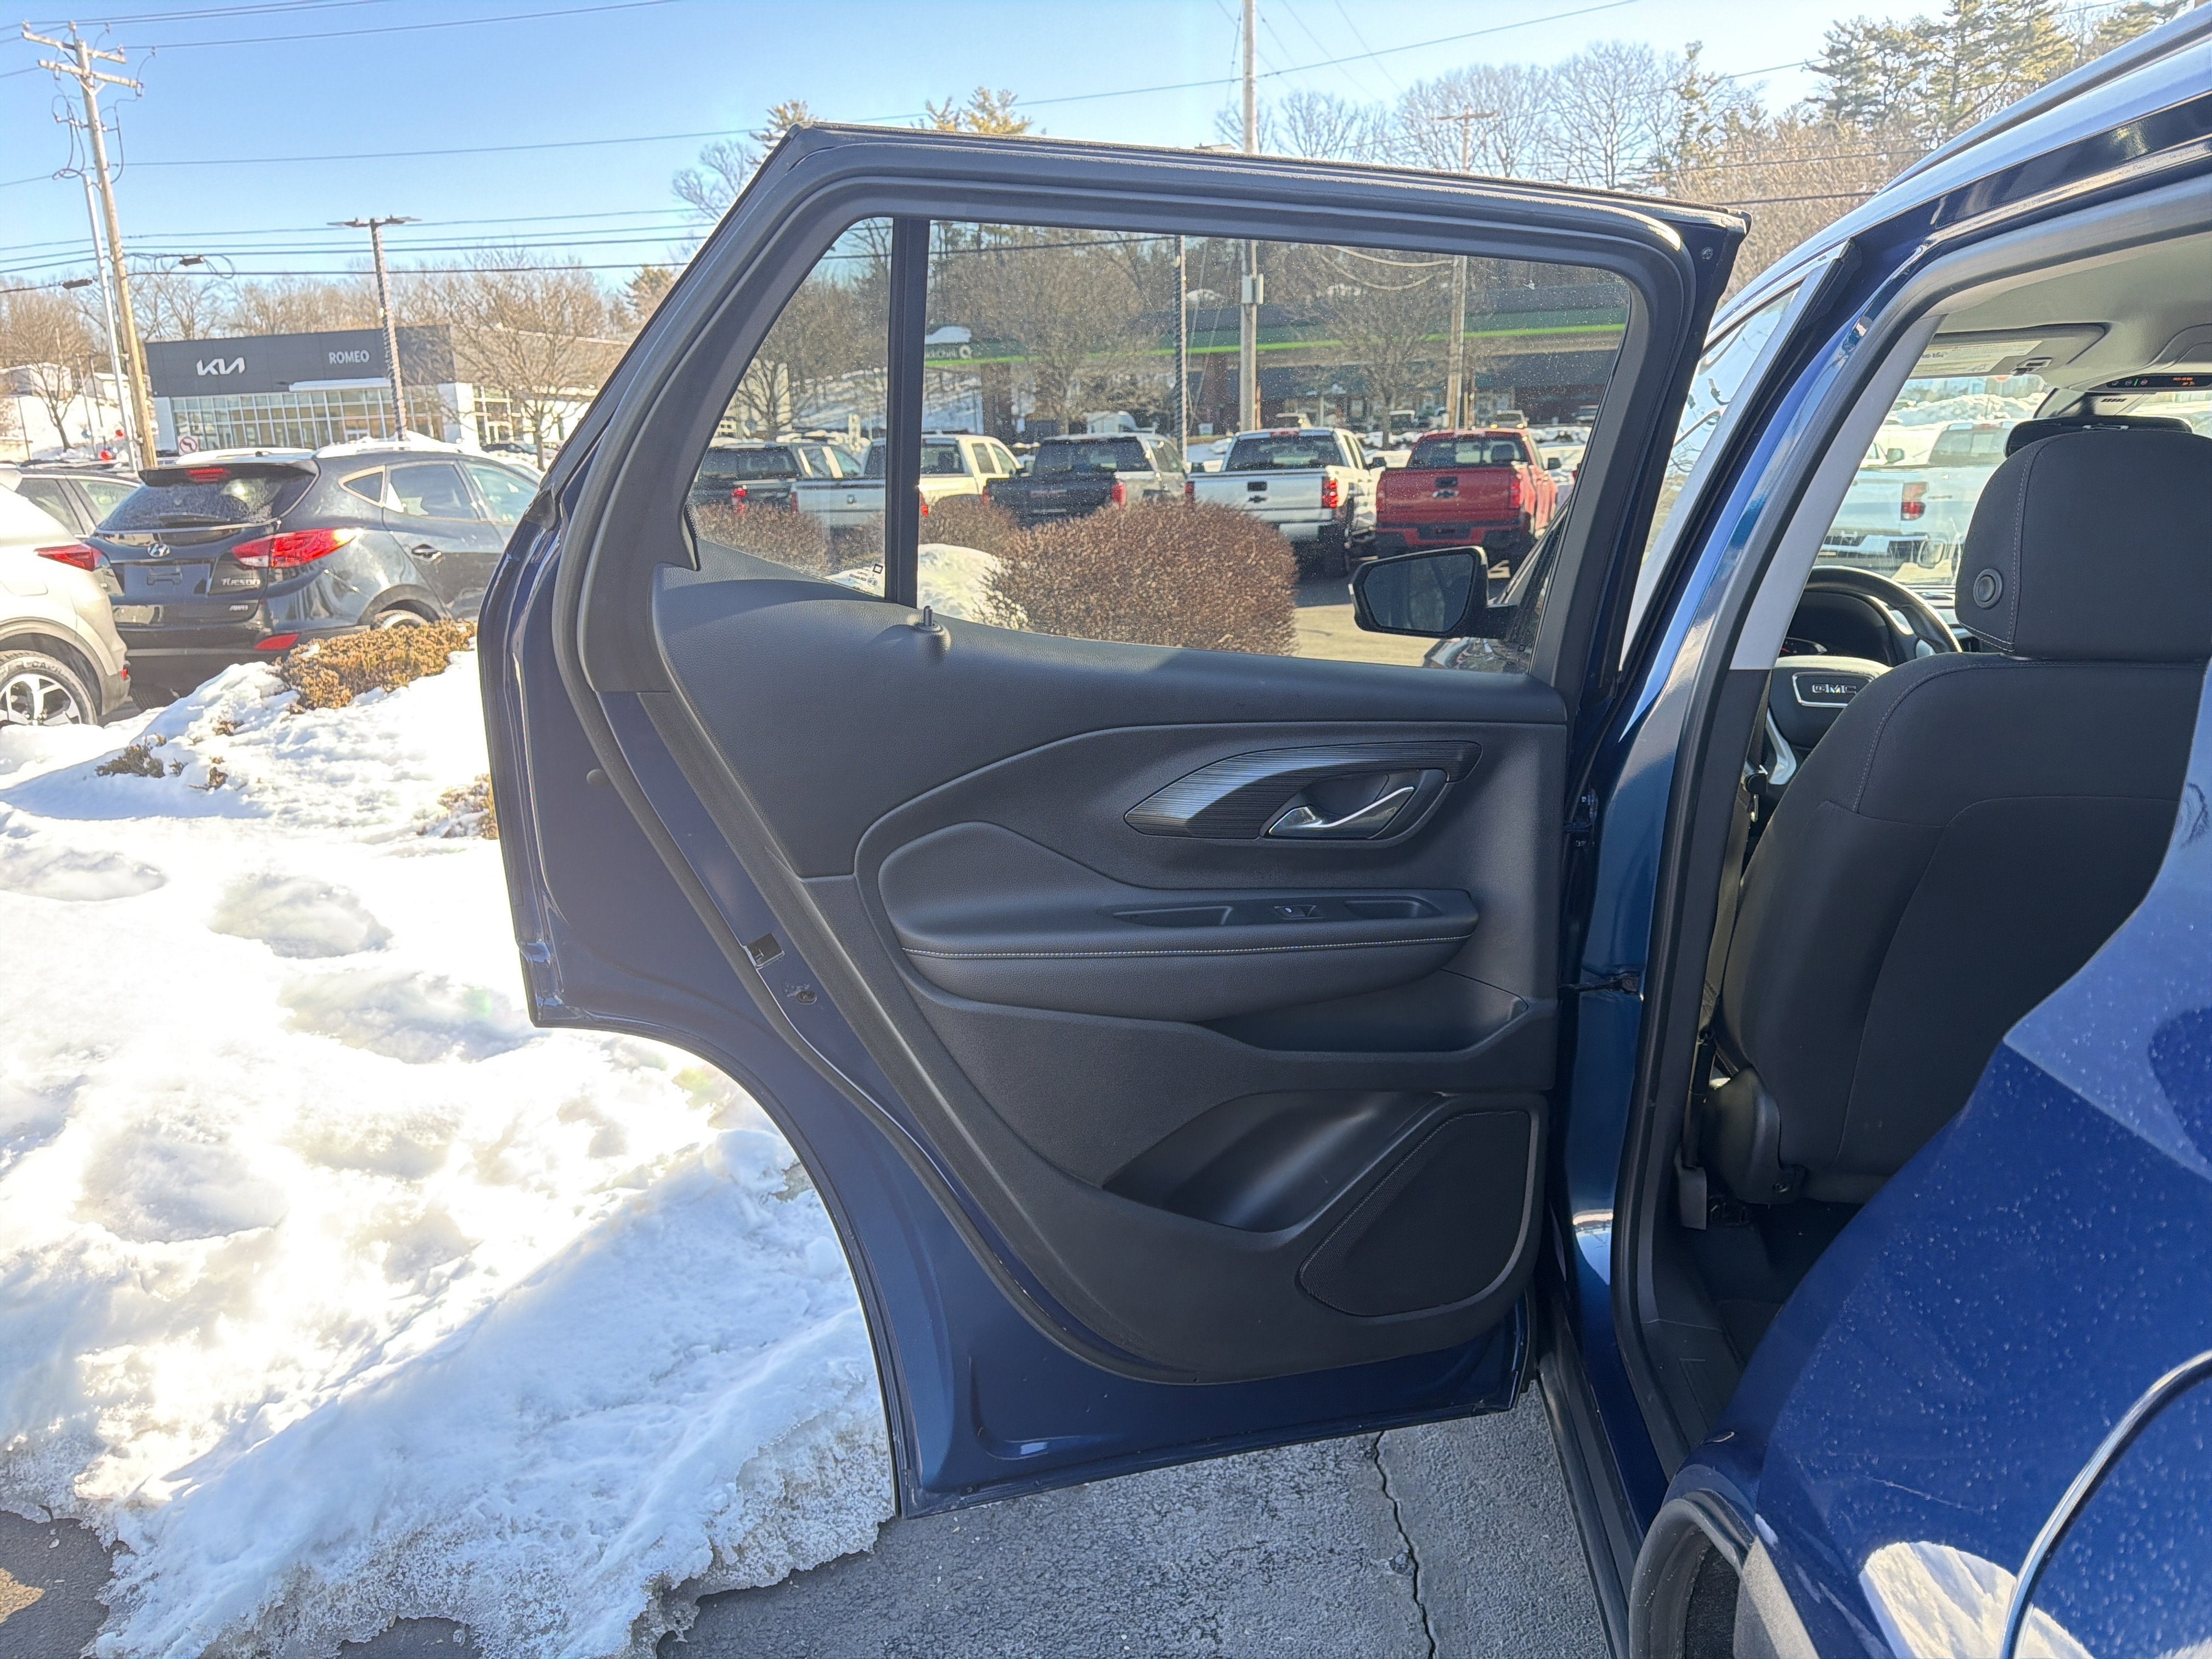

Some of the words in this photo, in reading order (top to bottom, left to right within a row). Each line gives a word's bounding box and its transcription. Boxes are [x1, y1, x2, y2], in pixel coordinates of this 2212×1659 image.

[329, 350, 370, 364] ROMEO
[196, 357, 245, 376] KIA
[1812, 684, 1857, 695] GMC
